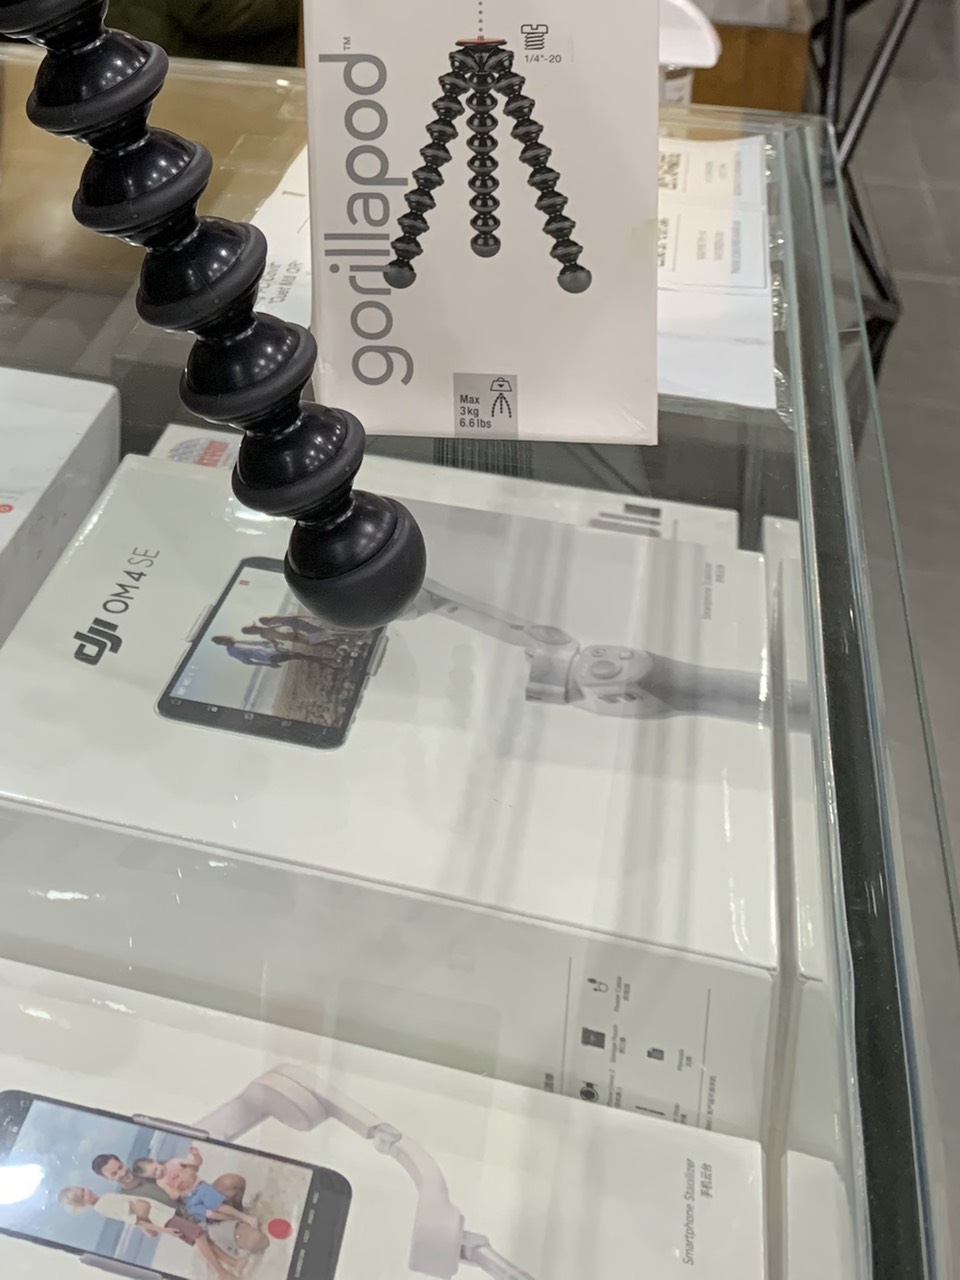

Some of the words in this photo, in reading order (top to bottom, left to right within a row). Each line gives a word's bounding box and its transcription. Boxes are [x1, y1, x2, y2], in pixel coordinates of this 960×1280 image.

[318, 53, 414, 386] gorillapod
[460, 394, 480, 405] Max
[127, 546, 160, 568] SE
[123, 569, 147, 583] 4
[102, 582, 140, 614] OM
